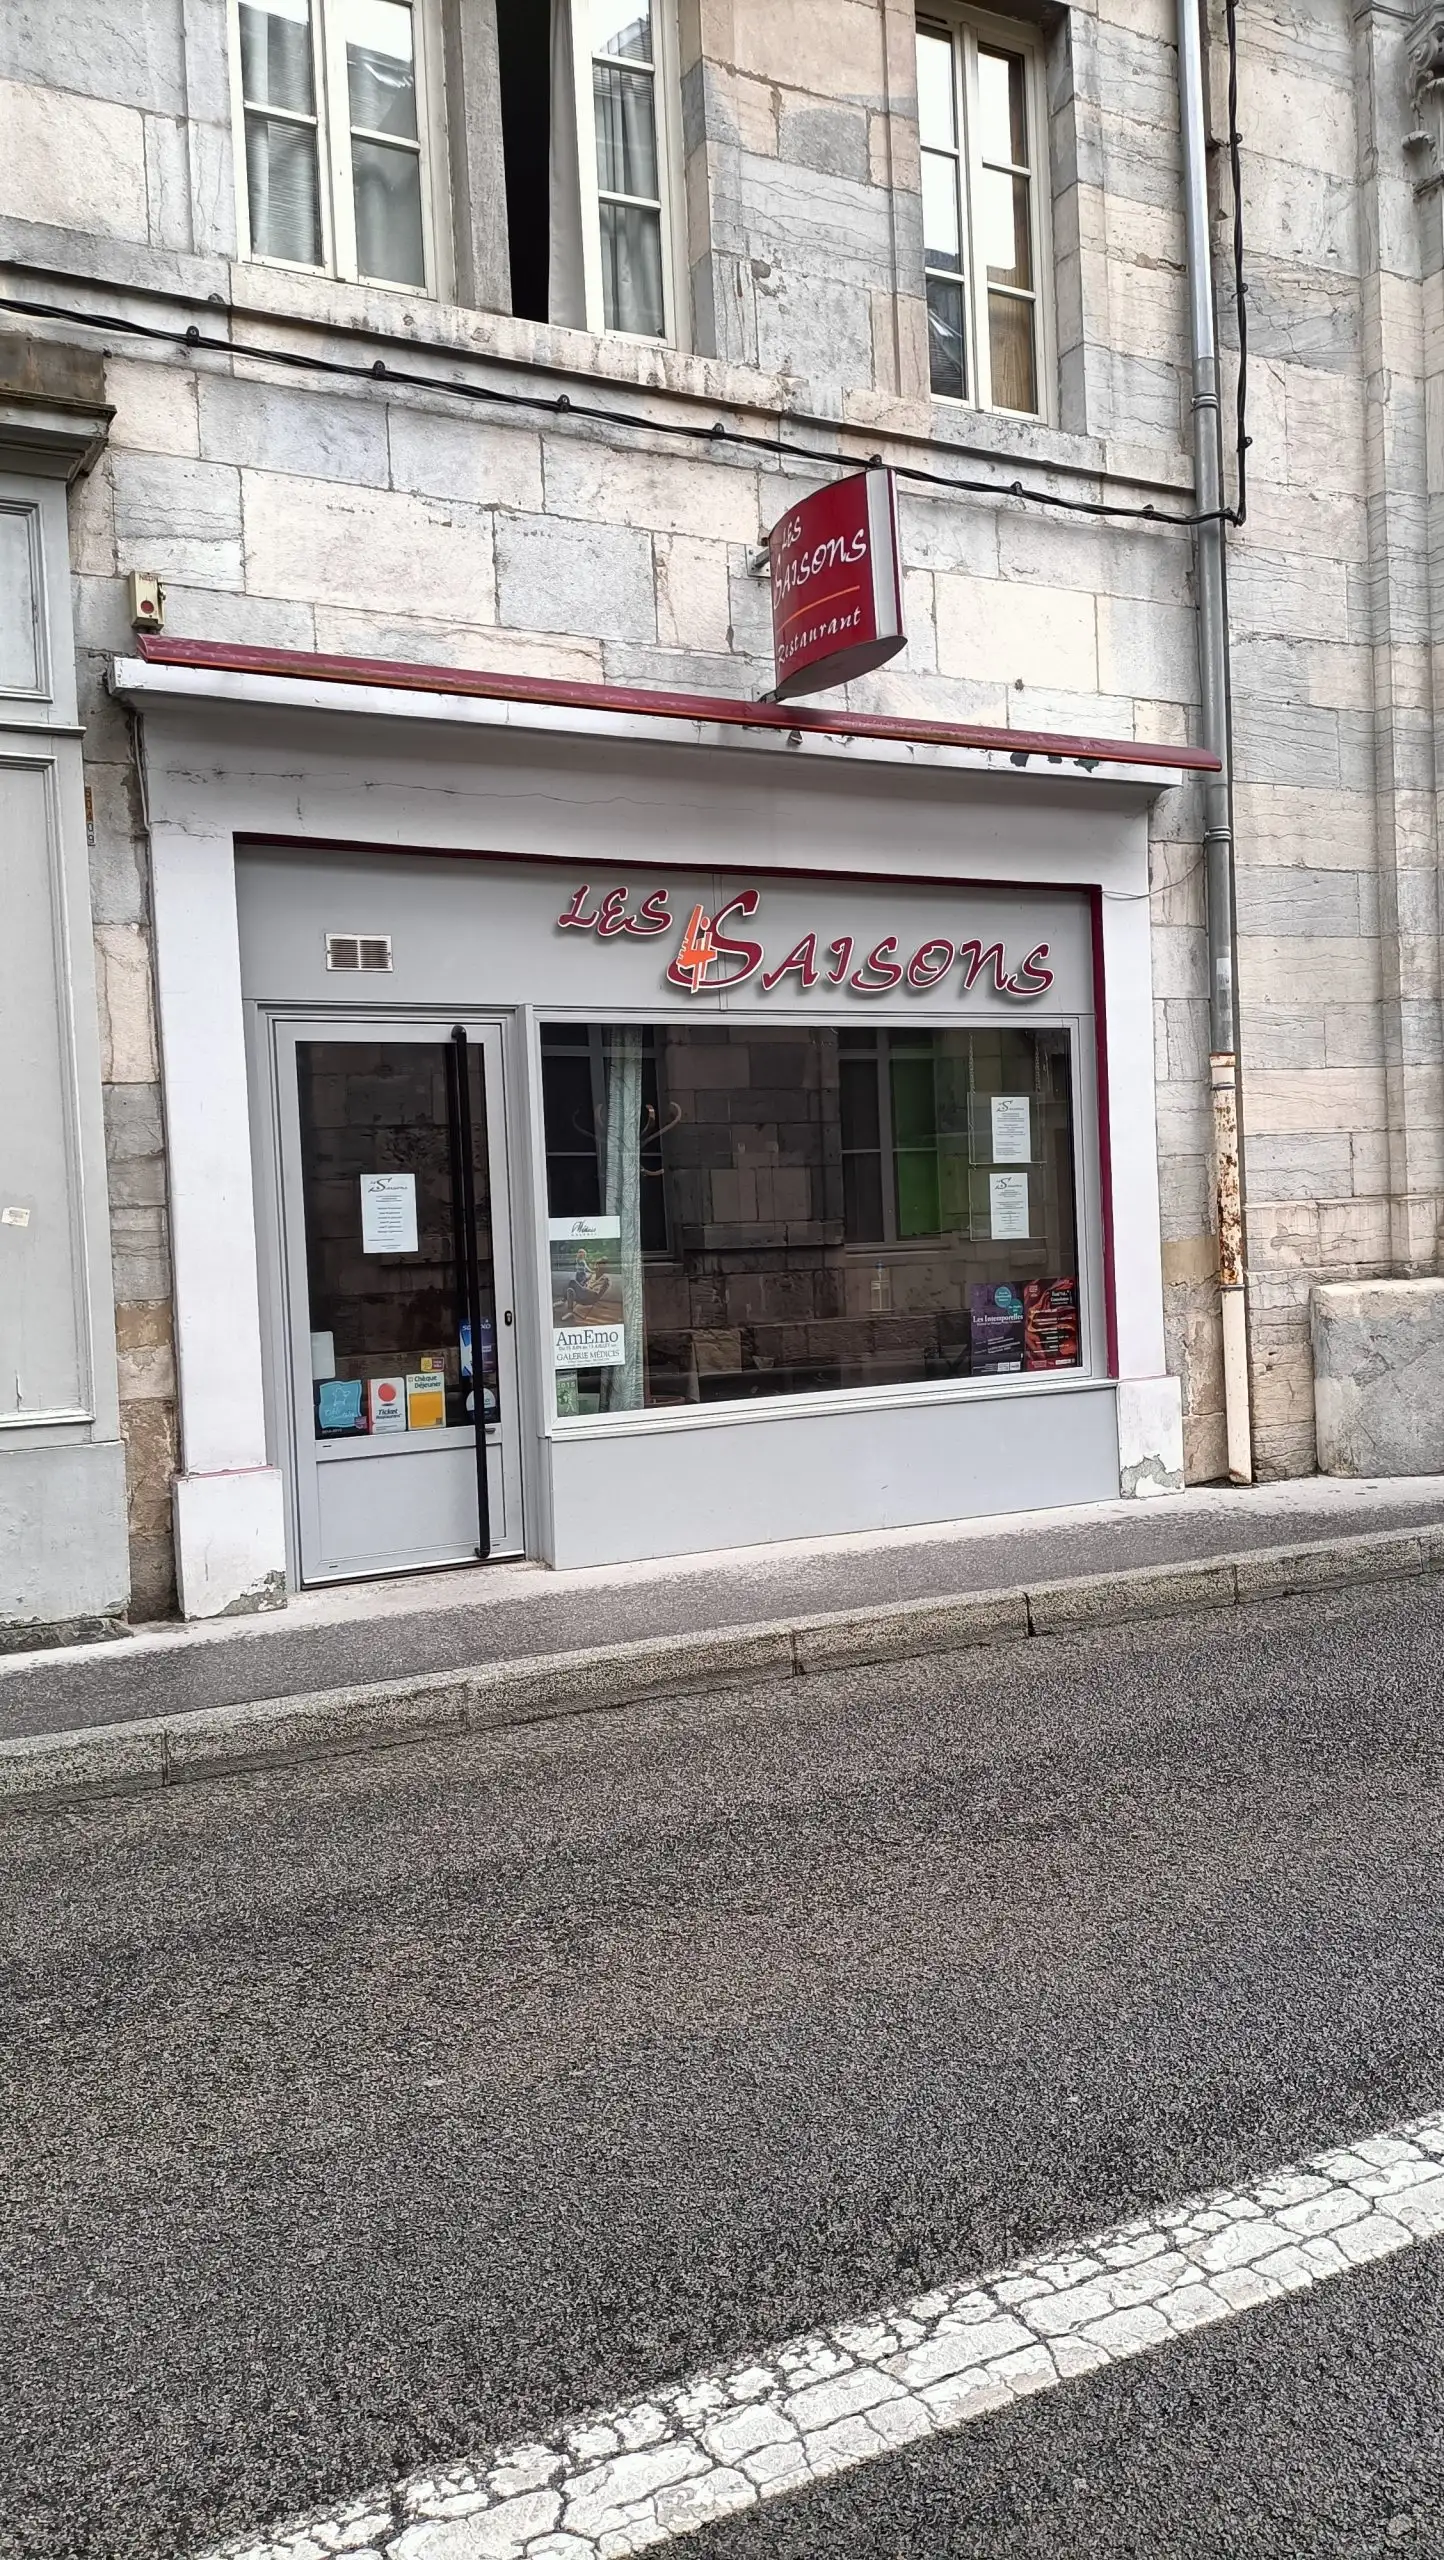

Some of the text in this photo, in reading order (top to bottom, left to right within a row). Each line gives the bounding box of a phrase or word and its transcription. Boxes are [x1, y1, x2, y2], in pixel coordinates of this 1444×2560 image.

[781, 515, 802, 549] LES
[777, 606, 862, 664] Restaurant
[557, 883, 673, 937] LES
[665, 888, 1055, 996] SAISONS
[556, 1329, 619, 1347] AmEmo
[556, 1352, 589, 1361] GALERIE
